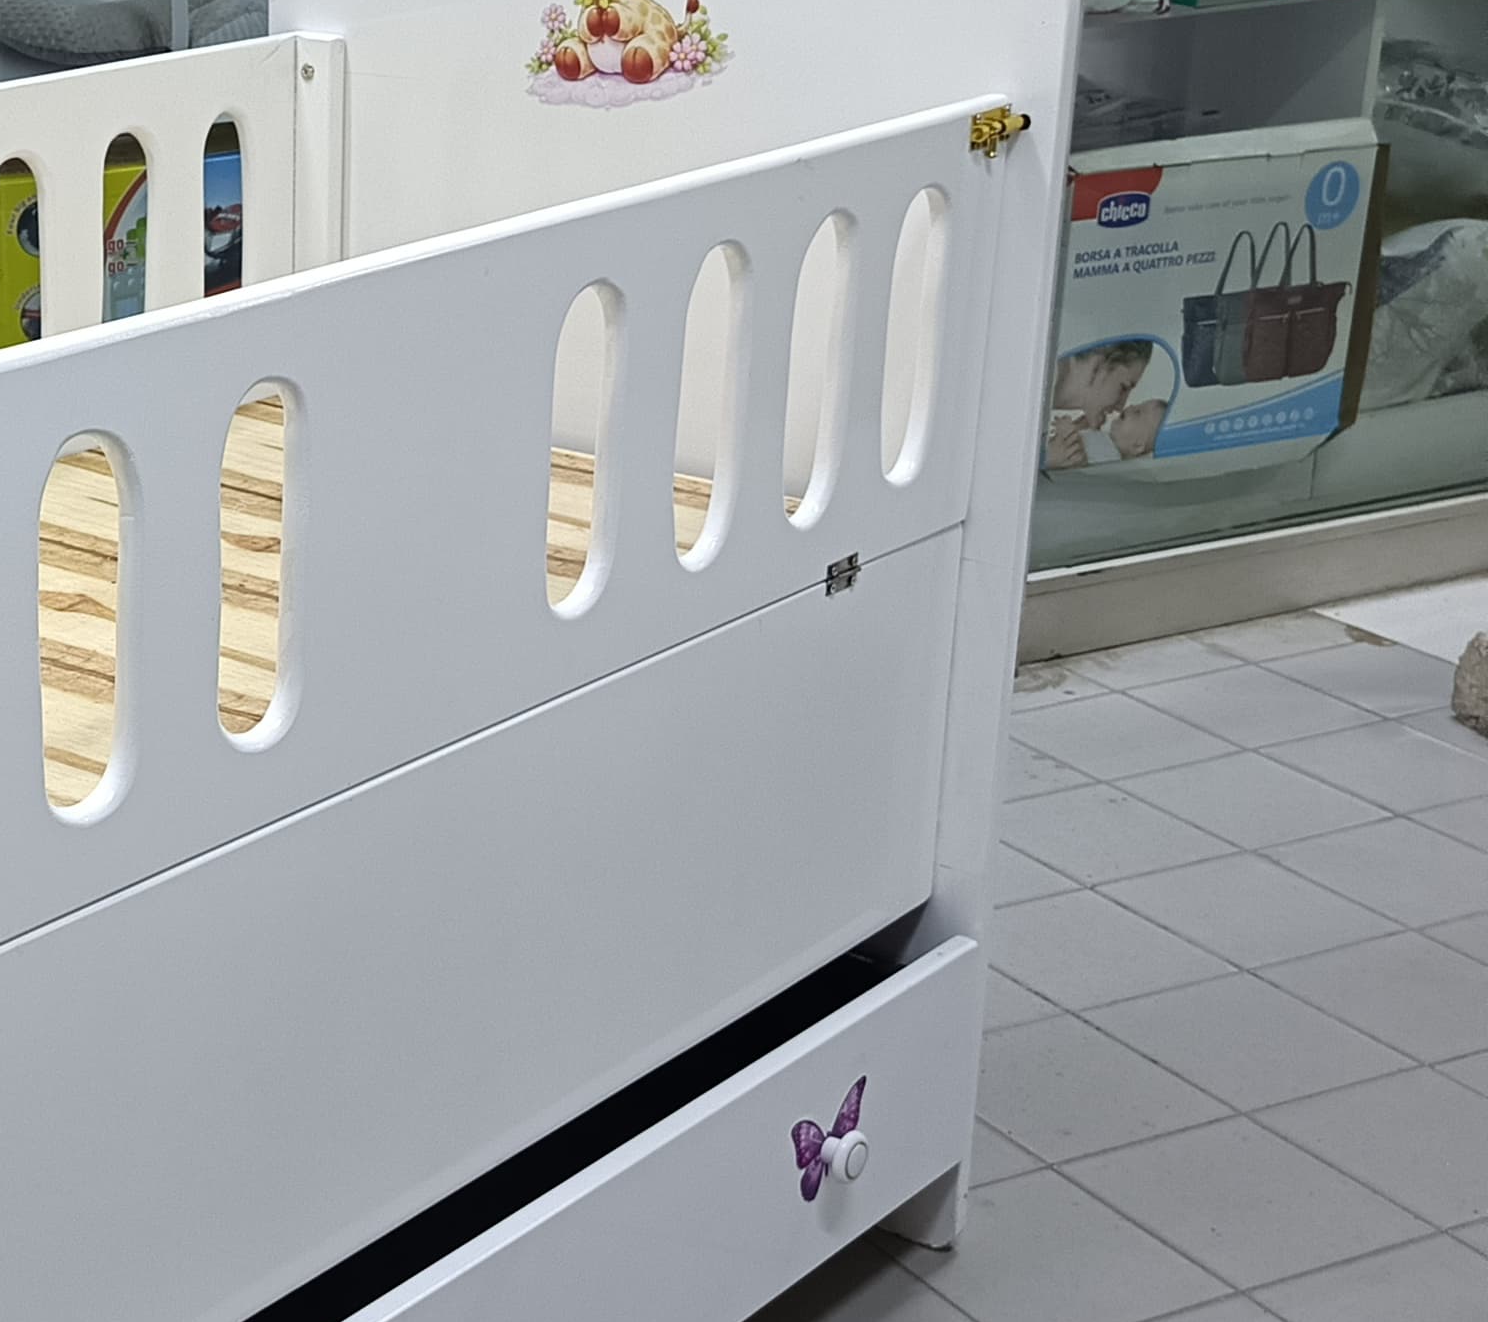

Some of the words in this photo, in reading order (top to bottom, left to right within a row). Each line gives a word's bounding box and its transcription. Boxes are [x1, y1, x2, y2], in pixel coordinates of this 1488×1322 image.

[1321, 165, 1346, 206] 0
[1100, 199, 1147, 223] chicco
[1075, 250, 1111, 264] BORSA
[1113, 249, 1122, 259] A
[1124, 241, 1179, 258] TRACOLLA
[1073, 264, 1120, 279] MAMMA
[1121, 263, 1130, 273] A
[1133, 256, 1183, 274] QUATTRO
